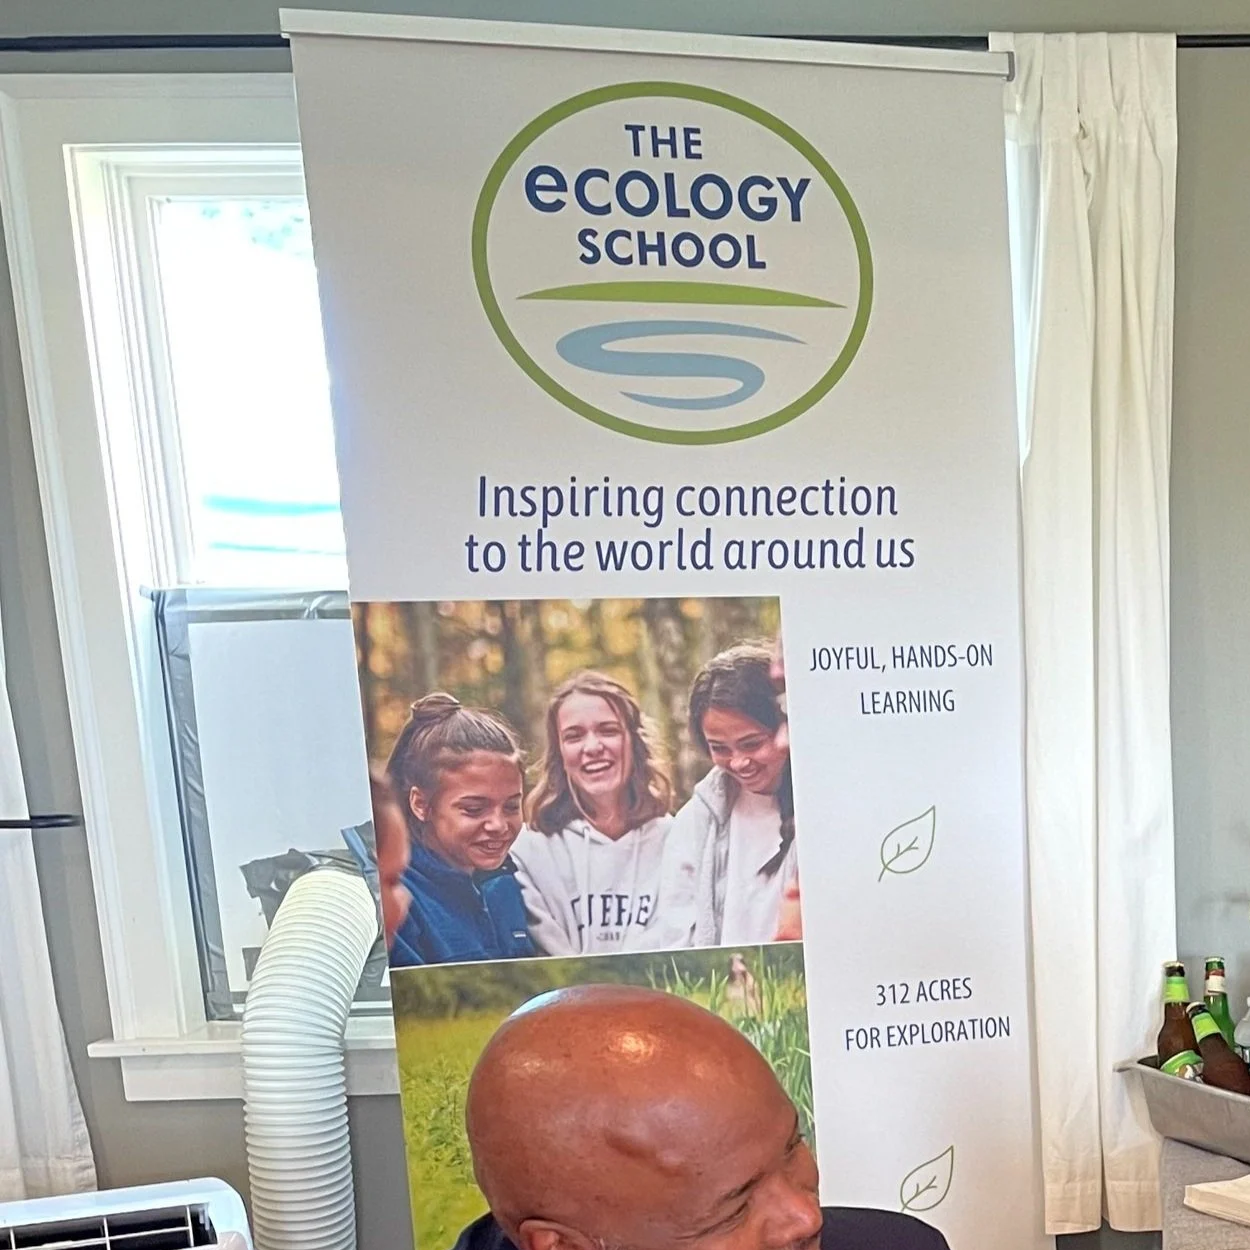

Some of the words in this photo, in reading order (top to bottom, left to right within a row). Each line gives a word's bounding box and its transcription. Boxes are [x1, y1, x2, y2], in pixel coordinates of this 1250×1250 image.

[624, 123, 703, 160] THE
[524, 164, 812, 223] eCOLOGY
[577, 227, 767, 270] SCHOOL
[478, 475, 664, 528] Inspiring
[676, 476, 898, 517] connection
[464, 534, 507, 573] to
[517, 530, 585, 573] the
[595, 527, 714, 572] world
[723, 526, 866, 571] around
[876, 538, 915, 569] us
[809, 646, 886, 673] JOYFUL,
[891, 643, 993, 669] HANDS-ON
[860, 689, 955, 715] LEARNING
[876, 982, 911, 1007] 312
[916, 976, 973, 1003] ACRES
[845, 1026, 881, 1051] FOR
[886, 1015, 1011, 1048] EXPLORATION
